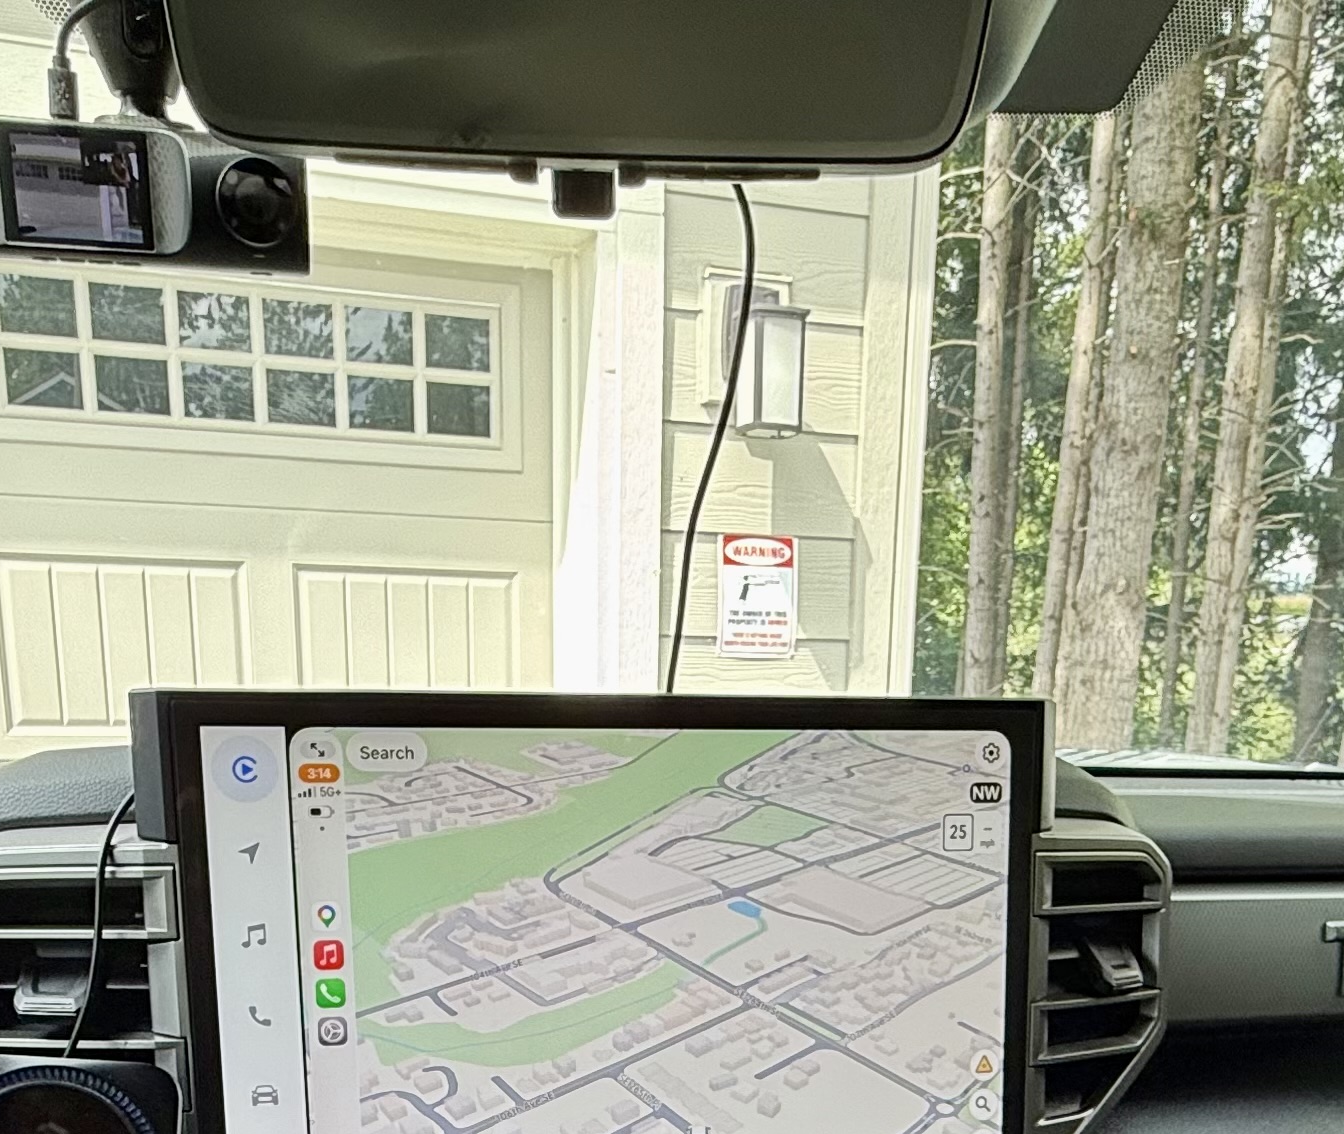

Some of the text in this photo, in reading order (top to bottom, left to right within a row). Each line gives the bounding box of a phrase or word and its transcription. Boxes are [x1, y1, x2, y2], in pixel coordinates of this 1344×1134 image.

[732, 546, 786, 559] WARNING
[360, 746, 415, 760] Search
[307, 768, 331, 779] 3:14
[320, 786, 342, 798] 5G+
[972, 785, 1000, 801] NW
[949, 824, 967, 839] 25
